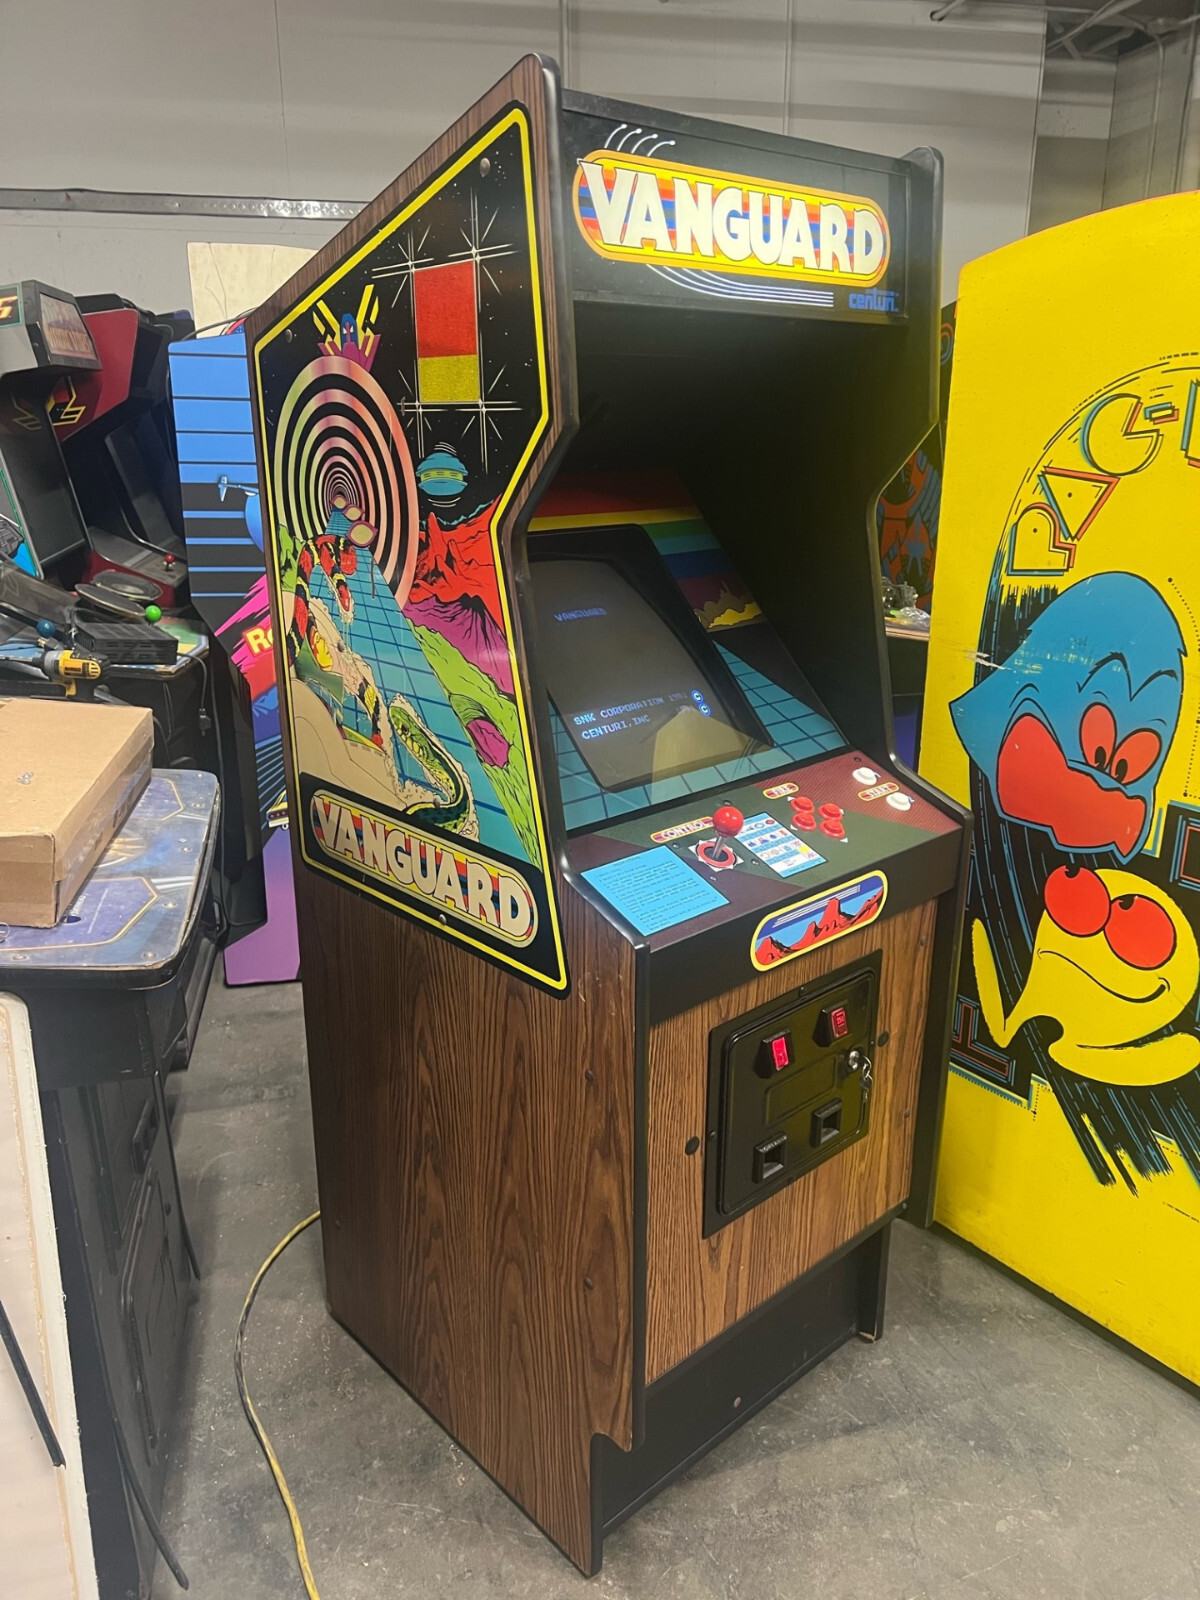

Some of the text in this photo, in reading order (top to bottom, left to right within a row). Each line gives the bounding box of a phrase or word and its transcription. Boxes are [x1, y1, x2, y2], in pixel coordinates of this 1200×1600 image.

[577, 158, 884, 275] VANGUARD
[573, 712, 597, 726] SNK
[600, 697, 665, 719] CORPORATION
[312, 794, 532, 938] VANGUARD
[660, 819, 705, 841] CONTROL
